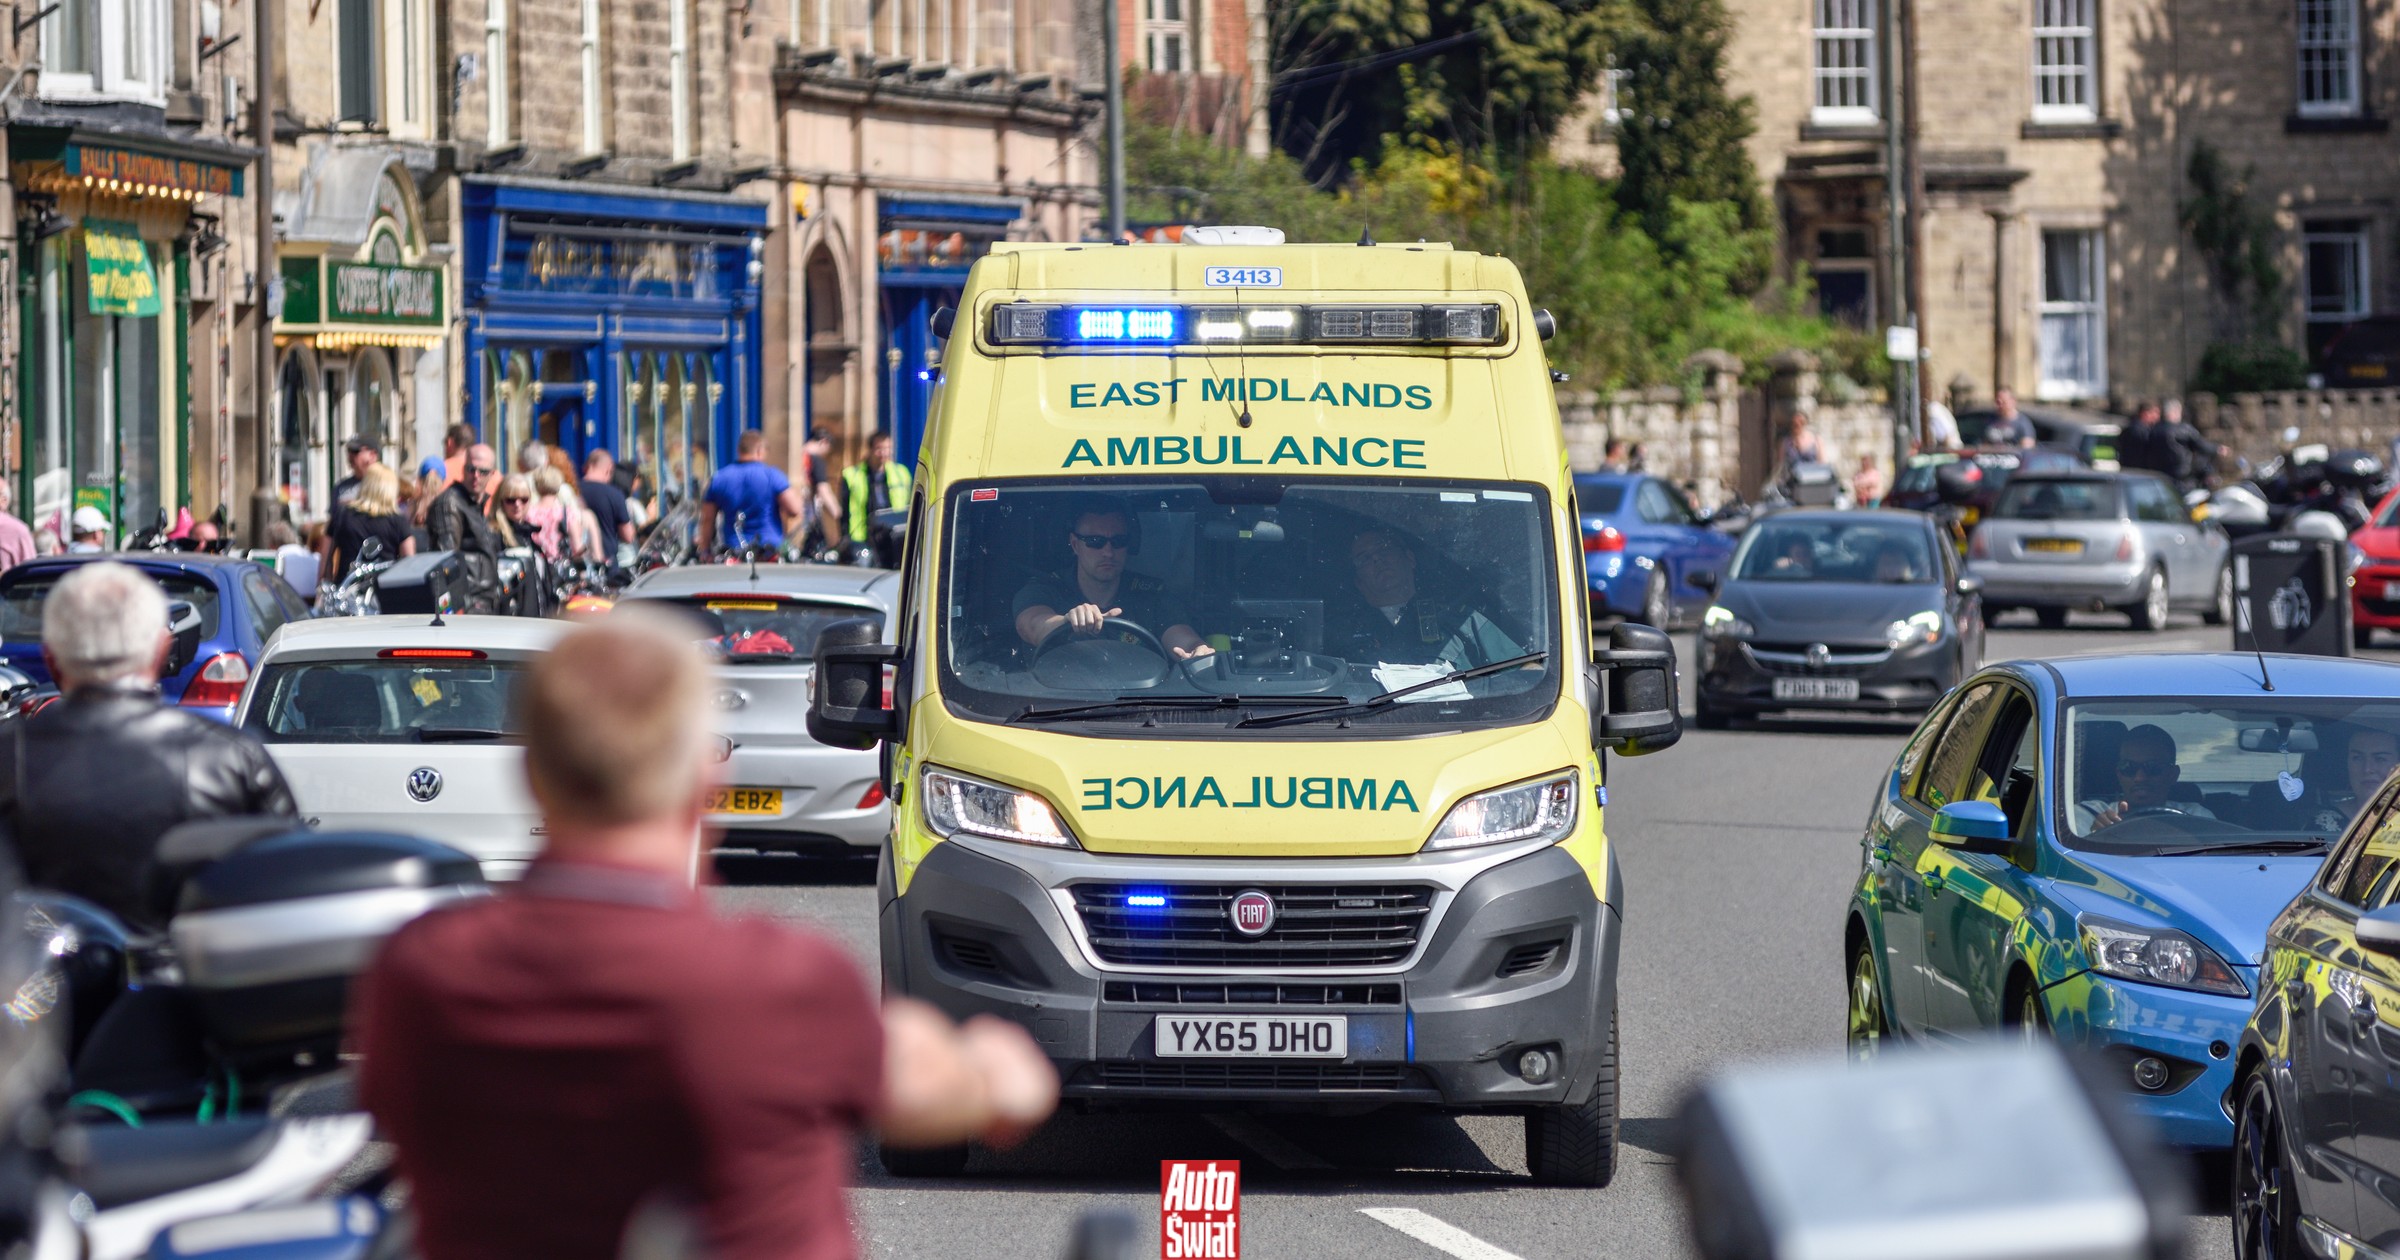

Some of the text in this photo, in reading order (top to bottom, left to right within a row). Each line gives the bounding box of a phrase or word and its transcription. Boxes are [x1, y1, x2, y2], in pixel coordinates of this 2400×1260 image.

[1215, 269, 1272, 285] 3413
[1070, 378, 1433, 410] EAST MIDLANDS
[1061, 435, 1427, 470] AMBULANCE
[733, 791, 774, 810] EBZ
[1240, 904, 1265, 924] FIAT
[1170, 1021, 1332, 1052] YX65 DHO
